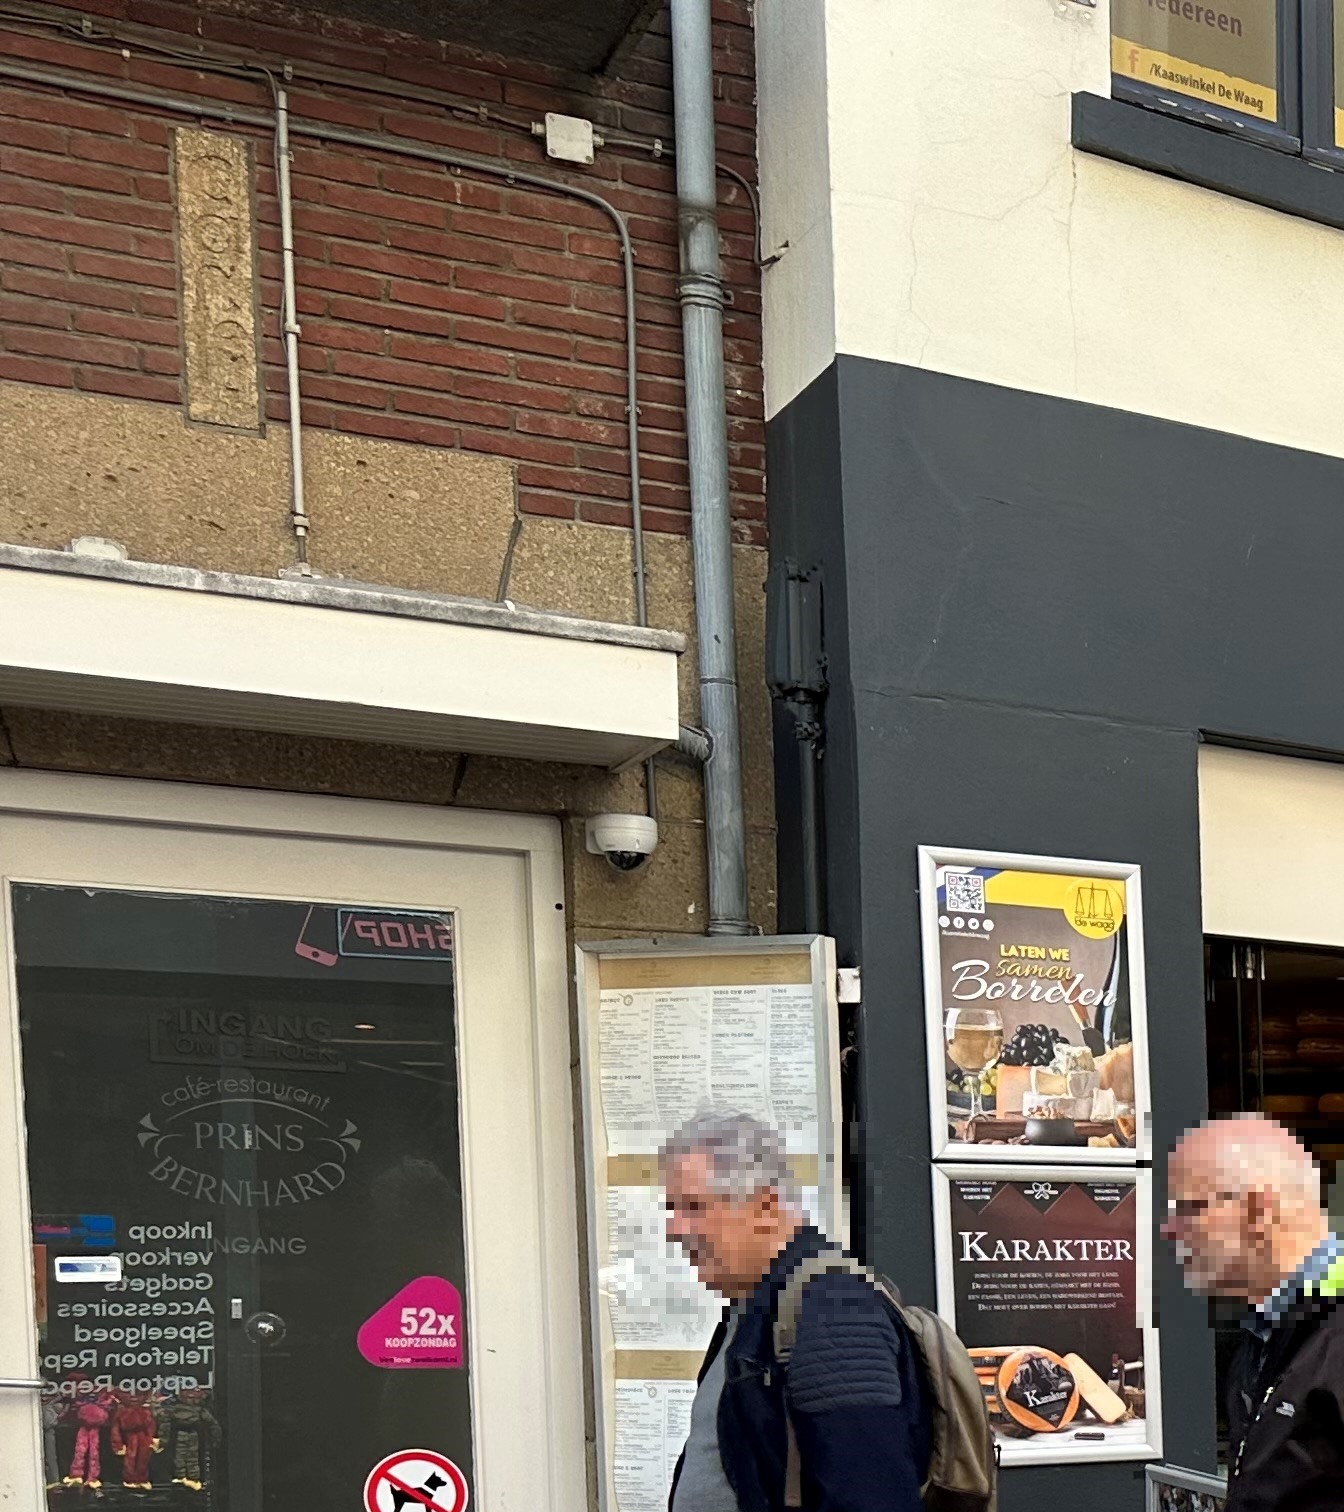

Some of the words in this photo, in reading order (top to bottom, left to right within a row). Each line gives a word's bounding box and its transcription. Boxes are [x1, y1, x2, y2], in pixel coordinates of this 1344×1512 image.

[1150, 63, 1216, 95] /Kaaswinkel
[1218, 84, 1232, 100] De
[1234, 89, 1264, 112] Waag
[1000, 944, 1046, 959] LATEN
[1049, 947, 1071, 961] WE
[952, 959, 1118, 1006] Borrelen
[179, 1008, 333, 1040] INGANG
[194, 1121, 305, 1151] PRINS
[148, 1156, 346, 1207] BERNHARD
[400, 1307, 457, 1336] 52x
[385, 1337, 457, 1348] KOOPZONDAG
